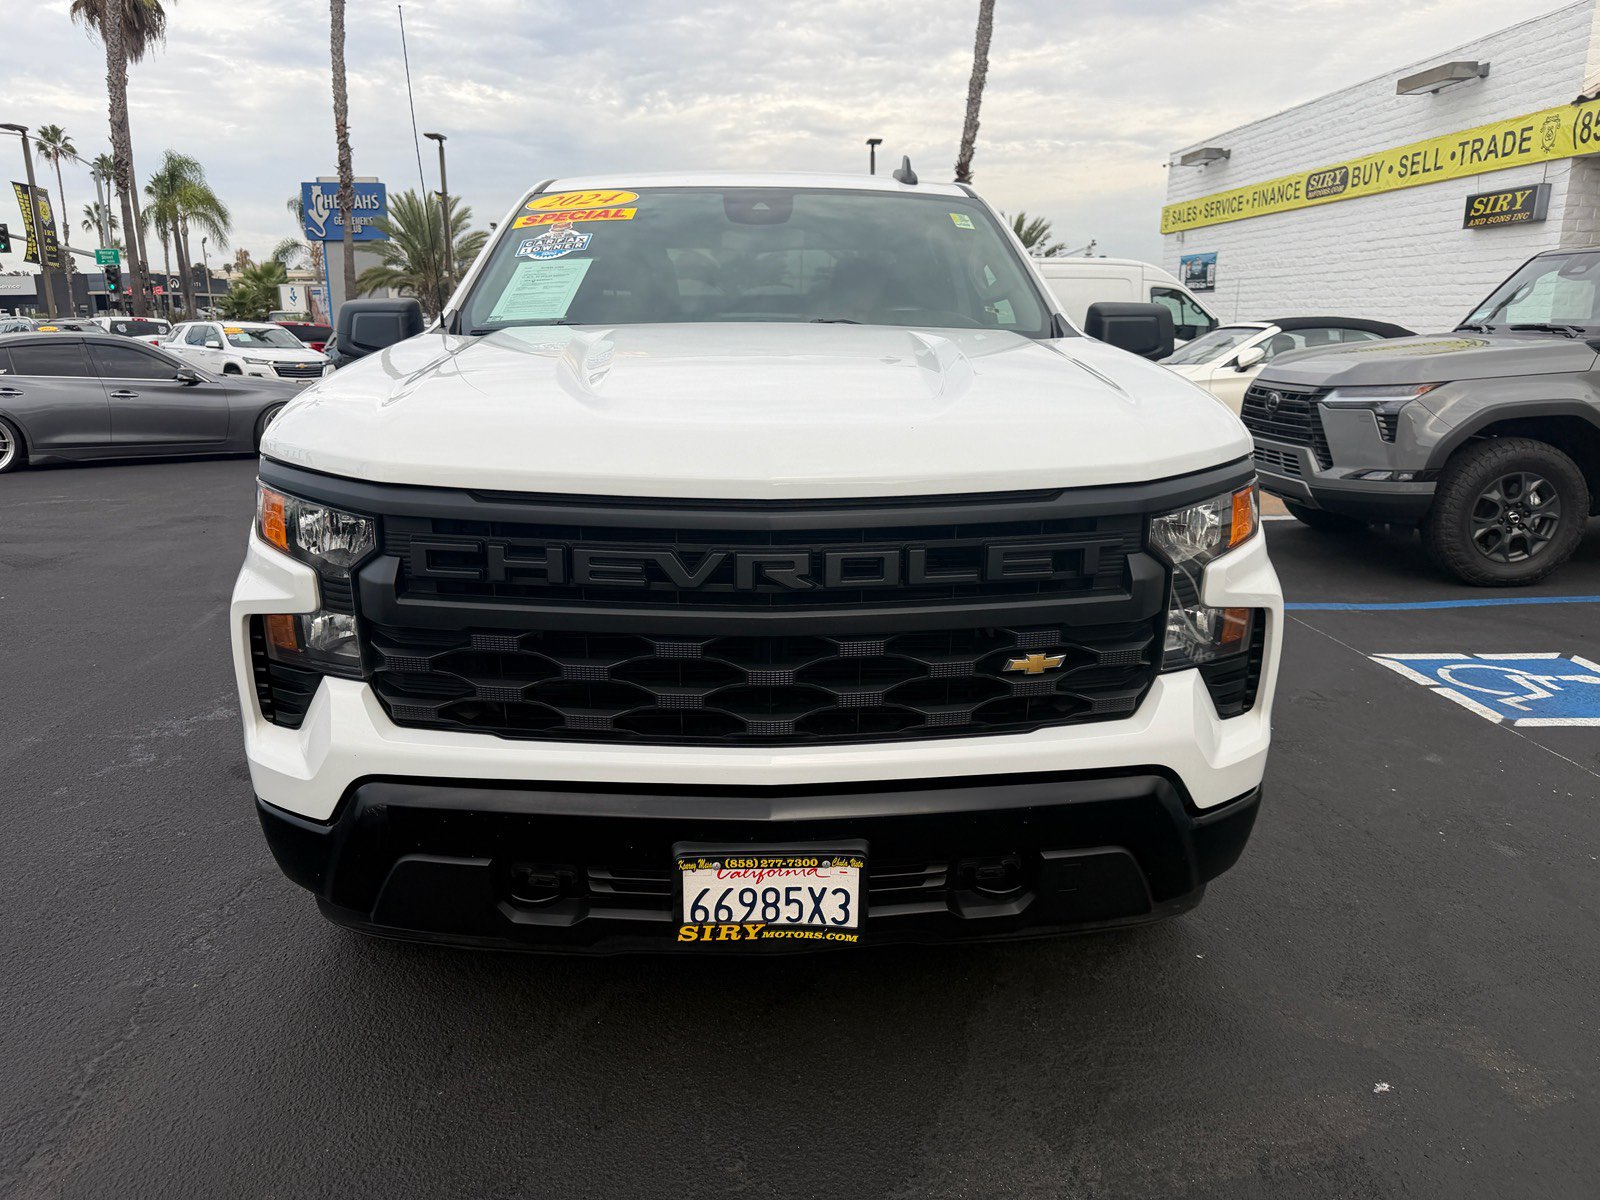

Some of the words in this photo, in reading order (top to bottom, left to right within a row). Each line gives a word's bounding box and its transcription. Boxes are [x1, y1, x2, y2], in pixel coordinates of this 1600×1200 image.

[1350, 159, 1385, 188] BUY
[1398, 147, 1444, 178] SELL
[1458, 125, 1534, 166] TRADE
[1308, 168, 1347, 191] SIRY
[540, 192, 624, 208] 2024
[1171, 207, 1198, 225] SALES
[1203, 195, 1244, 219] SERVICE
[1251, 181, 1301, 209] FINANCE
[1469, 189, 1532, 217] SIRY
[522, 209, 626, 226] SPECIAL
[1467, 218, 1486, 227] AND
[1487, 214, 1511, 224] SONS
[1512, 212, 1530, 220] INC
[525, 235, 589, 248] CARFAX
[533, 242, 584, 253] OWNER
[409, 537, 1126, 591] CHEVROLET
[724, 858, 759, 869] (858)
[760, 858, 818, 868] 277-7300
[716, 867, 831, 885] California
[690, 886, 851, 925] 66985X3
